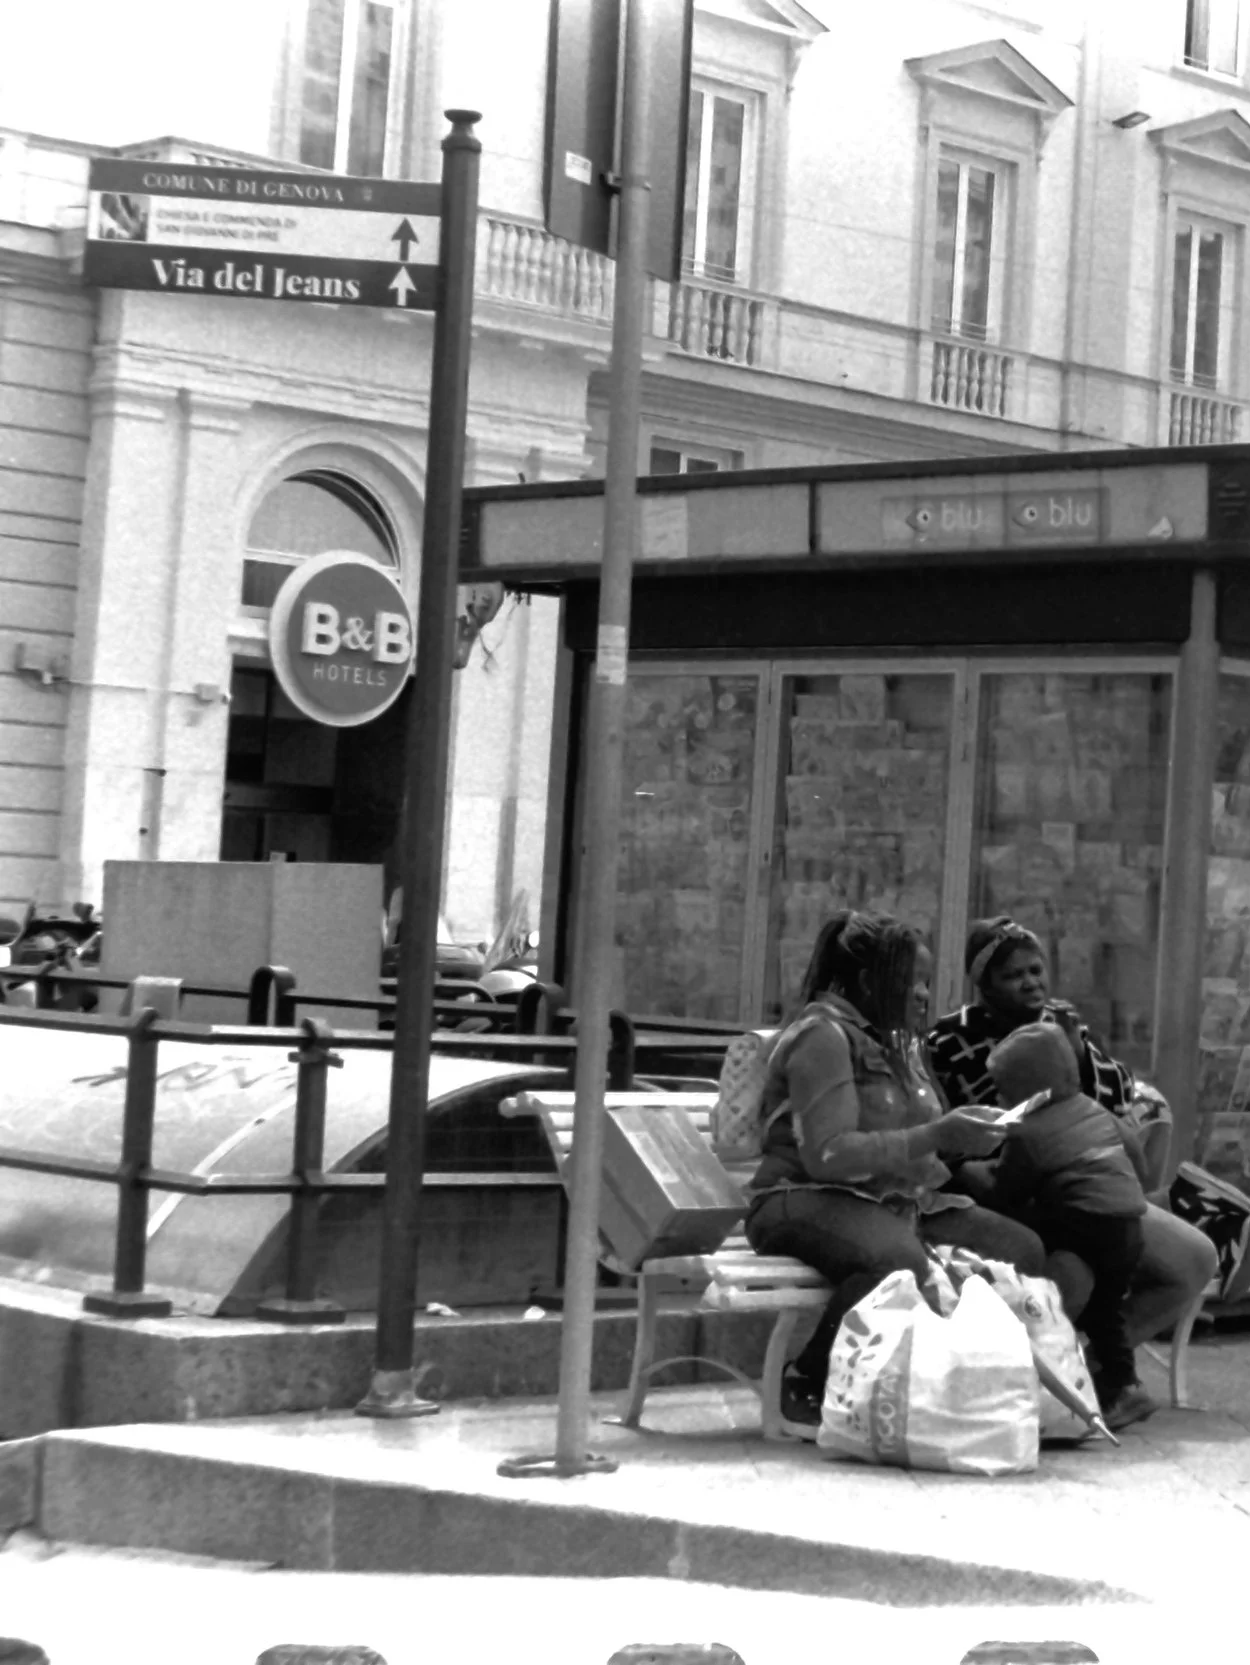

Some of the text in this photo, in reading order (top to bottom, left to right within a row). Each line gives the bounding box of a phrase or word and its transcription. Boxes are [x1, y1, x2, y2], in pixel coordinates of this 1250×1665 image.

[141, 172, 345, 203] COMUNE DI GENOVA
[152, 256, 362, 300] Via del Jeans
[940, 501, 983, 531] blu
[1048, 495, 1092, 527] blu
[301, 601, 411, 664] B&B
[312, 663, 388, 686] HOTELS
